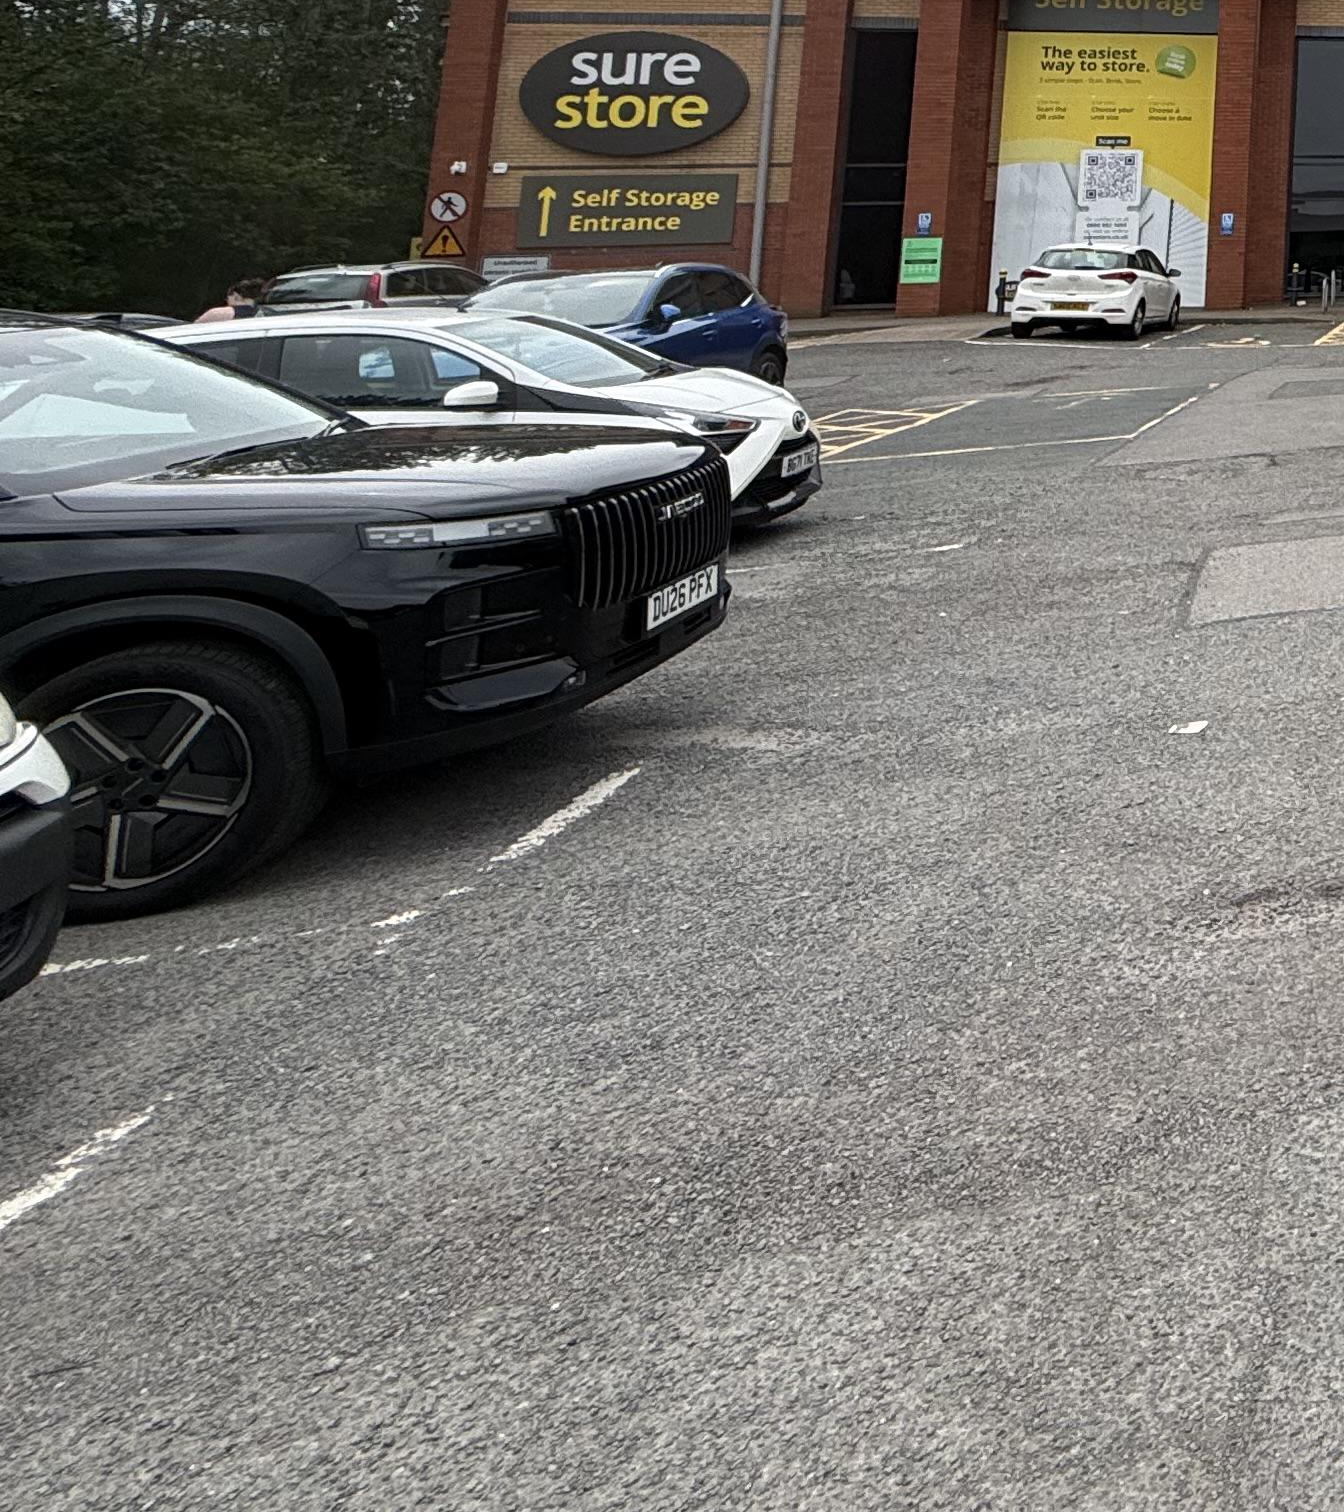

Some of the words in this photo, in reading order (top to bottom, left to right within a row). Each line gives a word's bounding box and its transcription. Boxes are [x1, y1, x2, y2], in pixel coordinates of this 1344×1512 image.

[1042, 46, 1072, 59] The
[1077, 47, 1137, 60] easiest
[570, 52, 701, 85] sure
[1041, 60, 1075, 75] way
[1080, 59, 1097, 72] to
[1102, 60, 1150, 73] store.
[554, 87, 708, 128] store
[572, 189, 621, 207] Self
[625, 189, 720, 210] Storage
[568, 214, 681, 232] Entrance
[652, 582, 686, 622] DU26
[689, 568, 714, 604] PFX
